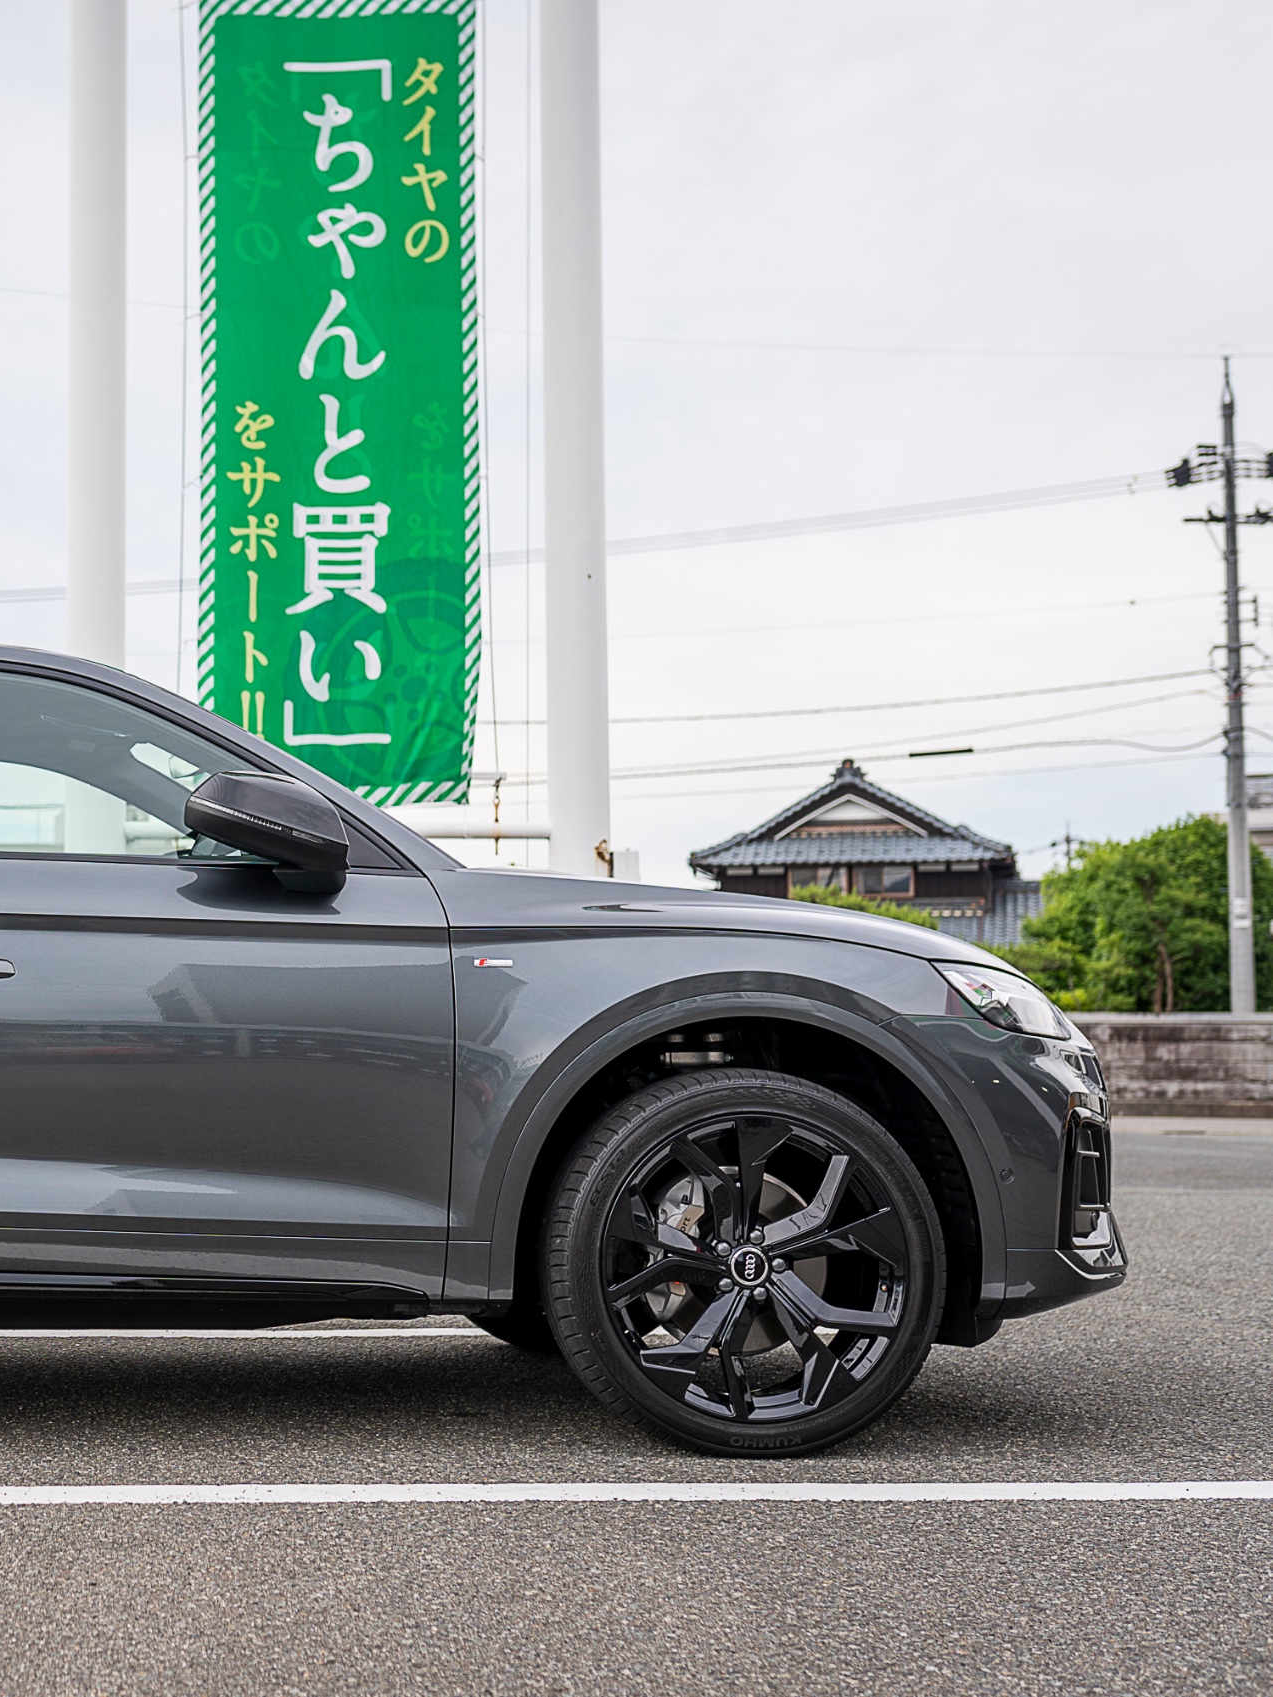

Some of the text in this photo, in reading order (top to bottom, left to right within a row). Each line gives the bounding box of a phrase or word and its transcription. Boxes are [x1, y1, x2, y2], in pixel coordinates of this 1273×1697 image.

[400, 57, 449, 264] タイヤの
[729, 1433, 801, 1447] KUMHO
